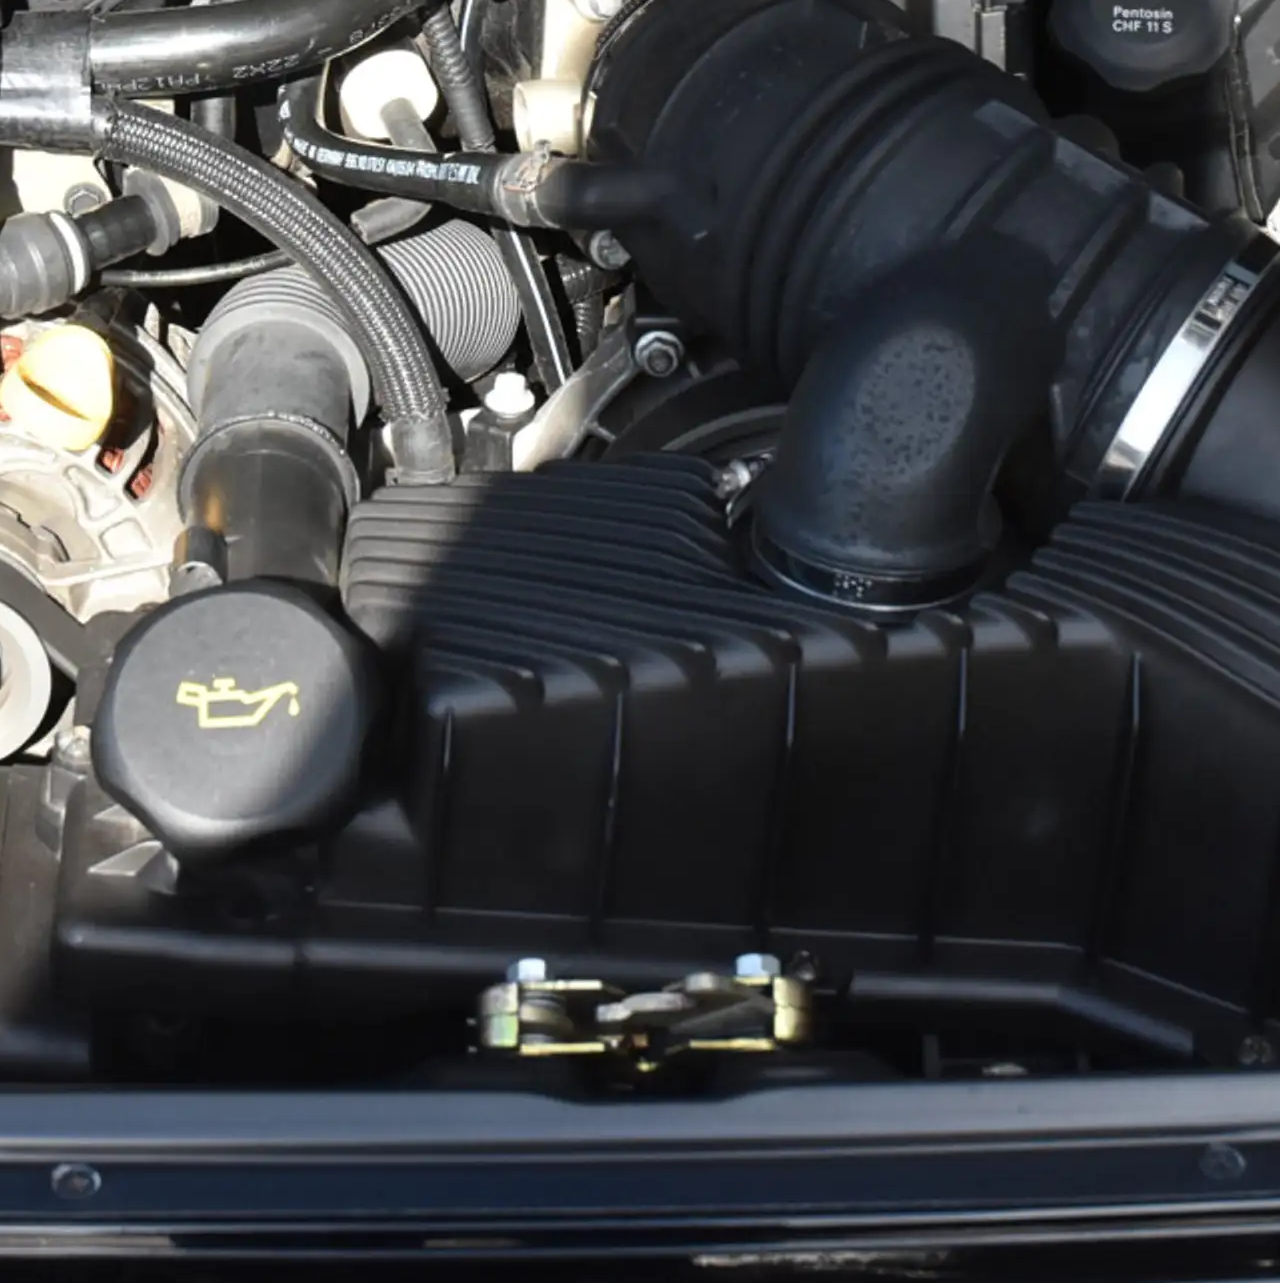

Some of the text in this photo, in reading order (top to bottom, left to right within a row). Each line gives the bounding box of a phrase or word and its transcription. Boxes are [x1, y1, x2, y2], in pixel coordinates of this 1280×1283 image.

[1113, 5, 1174, 19] Pentosin
[1112, 19, 1173, 34] CHF 11 S
